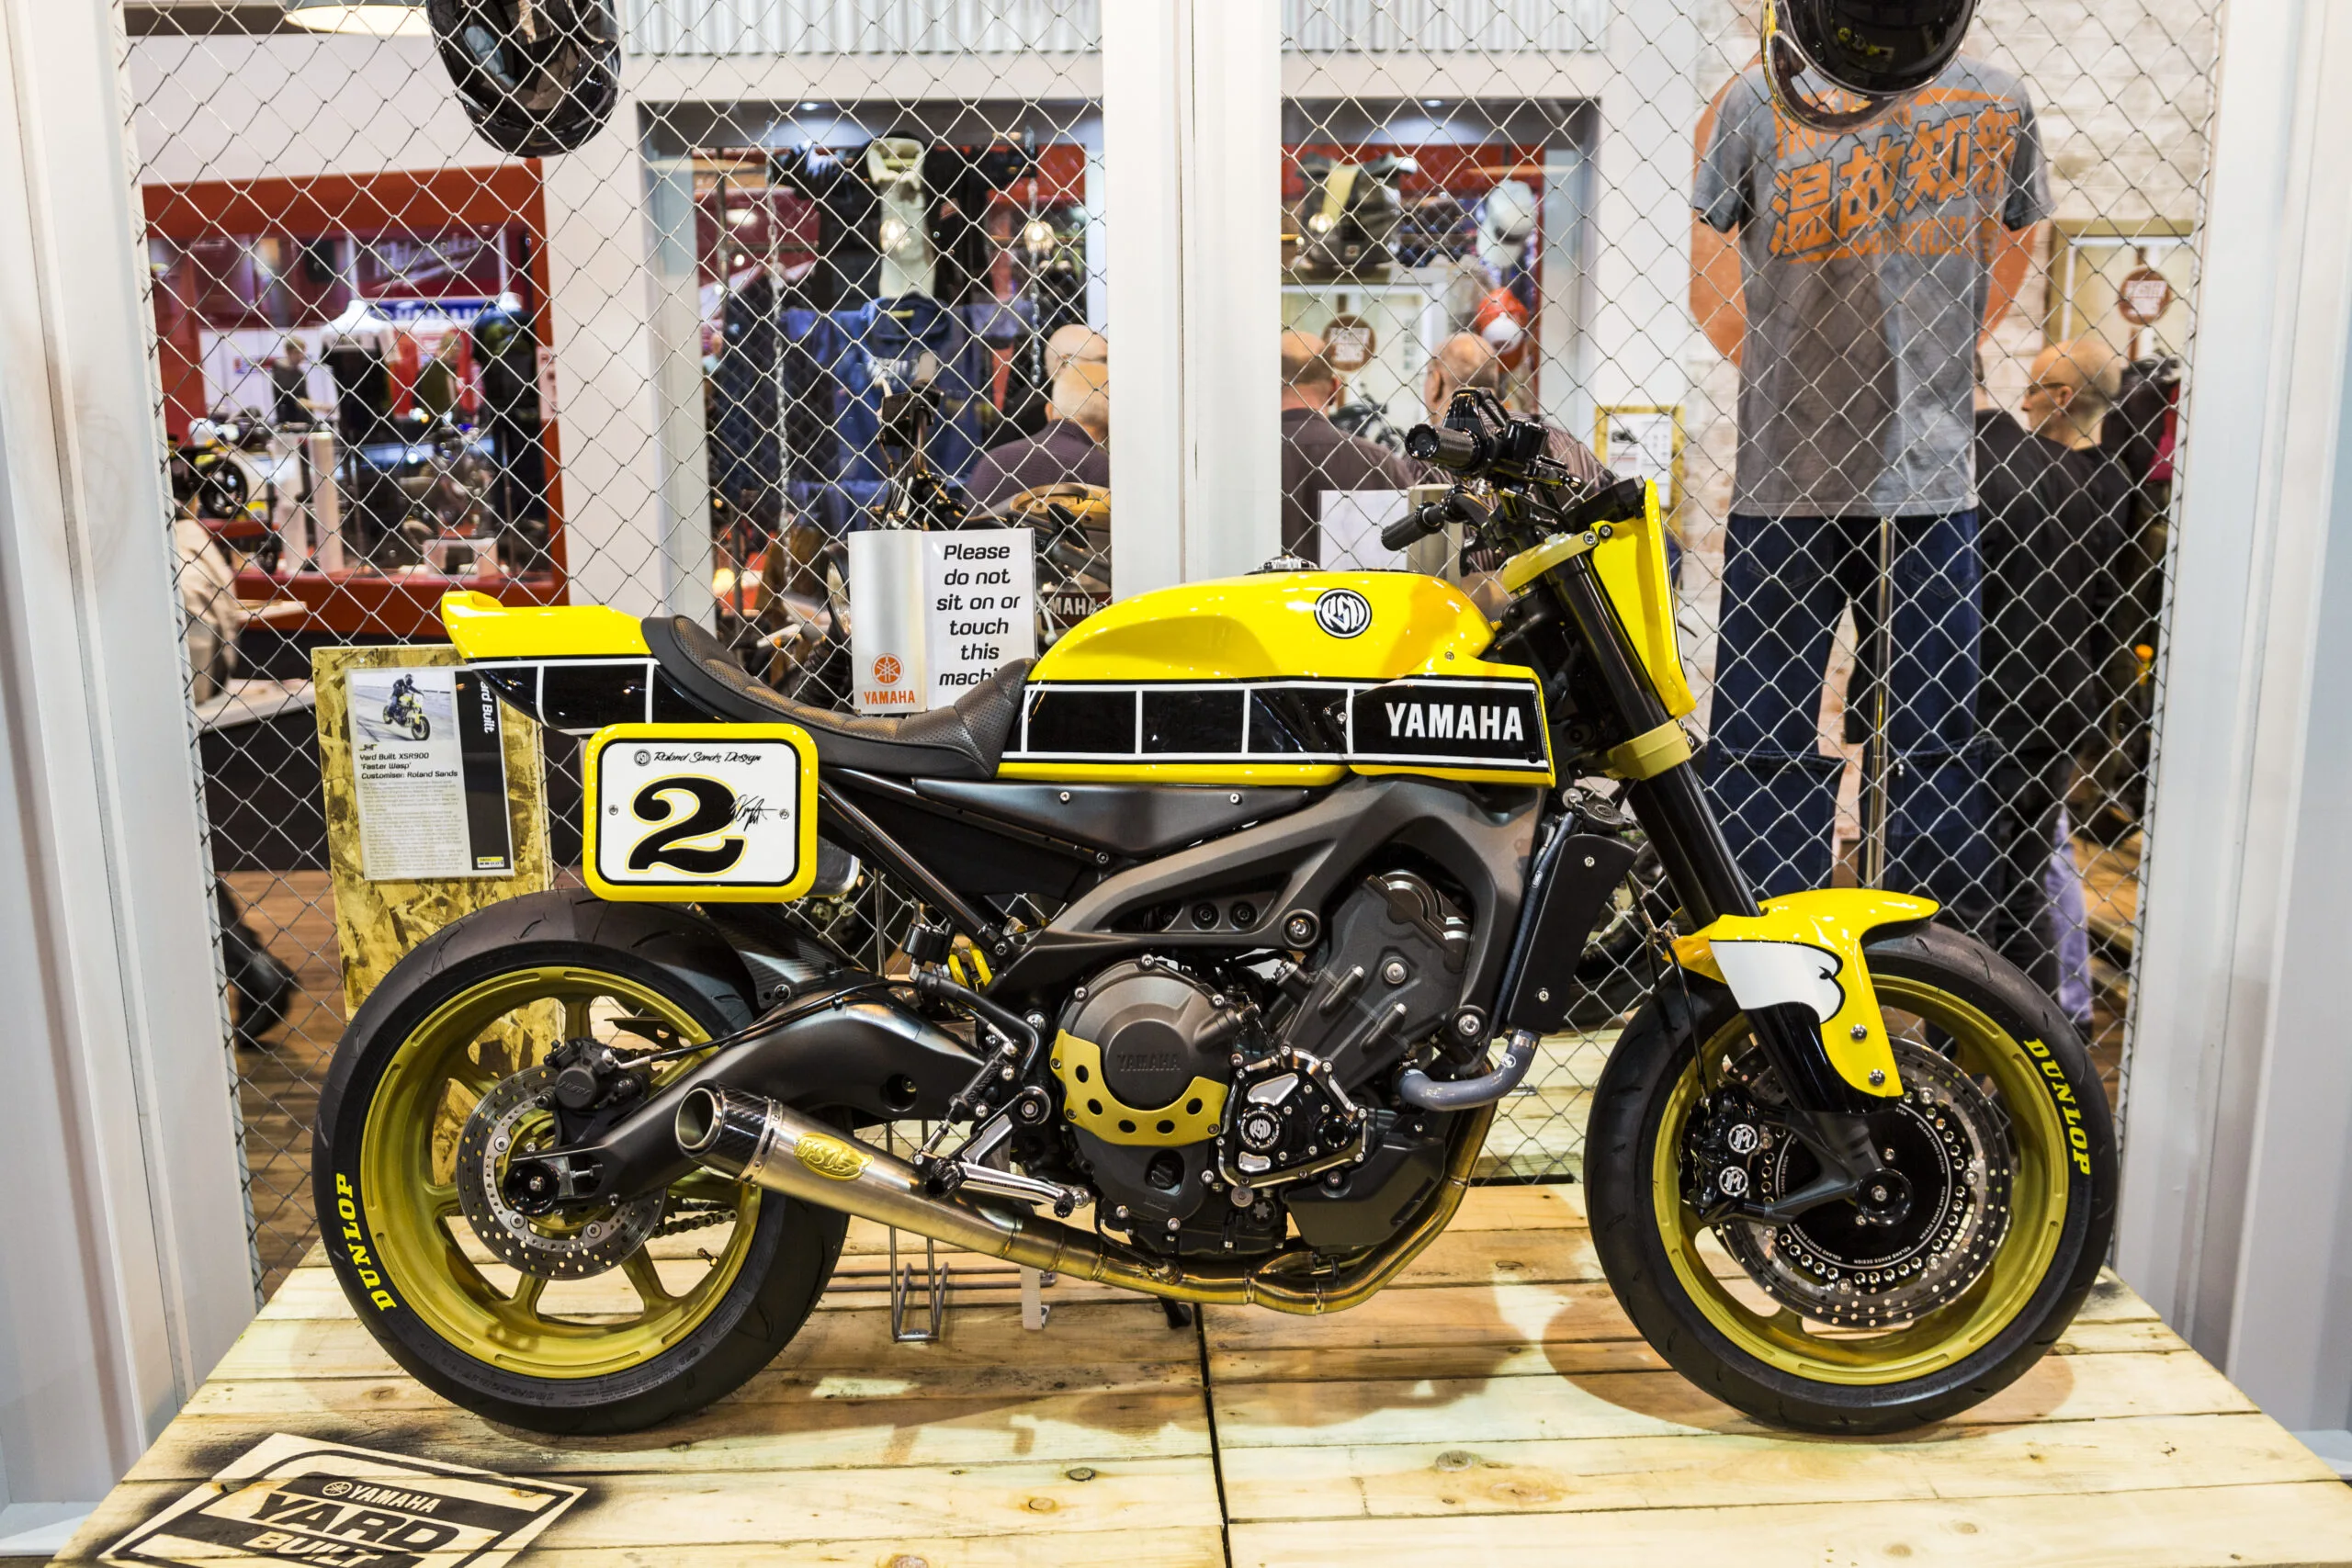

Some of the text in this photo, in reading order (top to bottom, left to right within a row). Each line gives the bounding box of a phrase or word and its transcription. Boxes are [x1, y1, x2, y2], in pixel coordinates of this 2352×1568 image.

[944, 544, 1011, 560] Please
[944, 569, 1011, 585] do not
[936, 594, 1021, 611] sit on or
[1041, 597, 1096, 615] MAHA
[949, 617, 1009, 636] touch
[961, 643, 1000, 660] this
[864, 690, 916, 705] YAMAHA
[481, 681, 495, 734] ard Built
[1385, 703, 1524, 740] YAMAHA
[627, 775, 746, 874] 2
[1117, 1054, 1181, 1072] YAMAHA
[2023, 1038, 2090, 1175] DUNLOP
[336, 1173, 397, 1311] DUNLOP
[346, 1485, 441, 1513] YAMAHA
[248, 1493, 459, 1551] YARD
